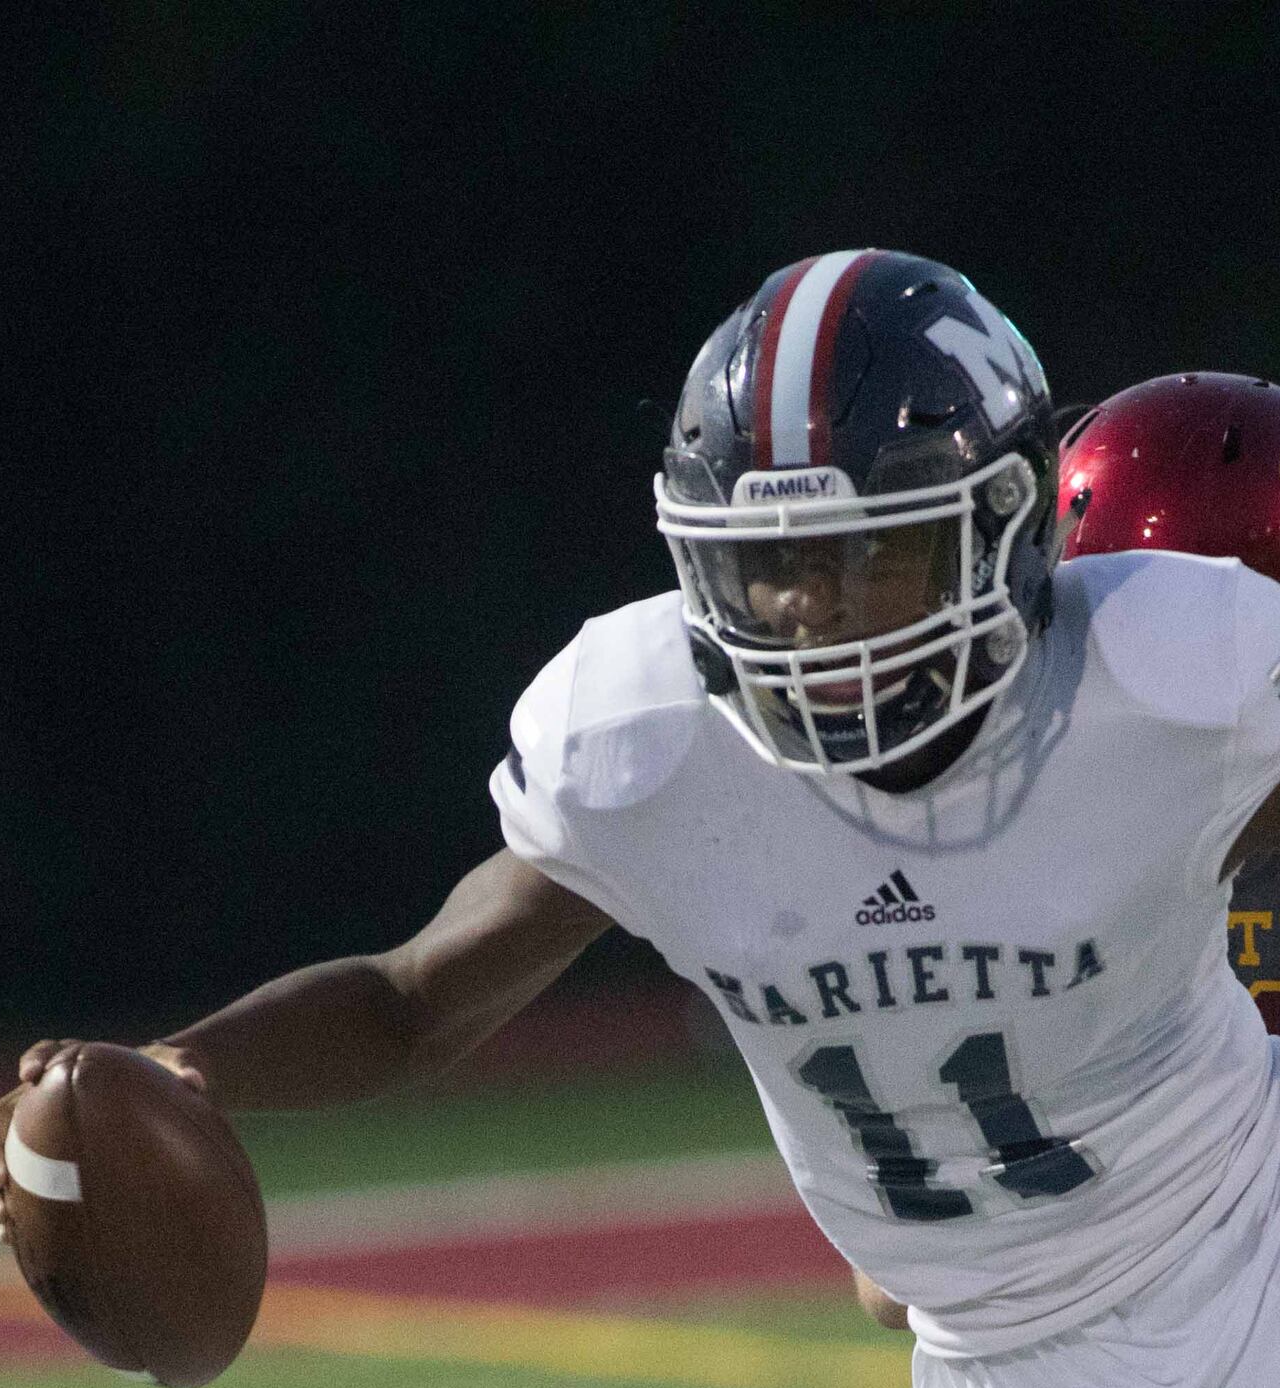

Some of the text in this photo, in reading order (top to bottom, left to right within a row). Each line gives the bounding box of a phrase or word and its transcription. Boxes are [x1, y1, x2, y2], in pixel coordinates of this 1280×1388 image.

[749, 473, 830, 500] FAMILY
[856, 902, 935, 925] adidas
[796, 1030, 1097, 1222] 11
